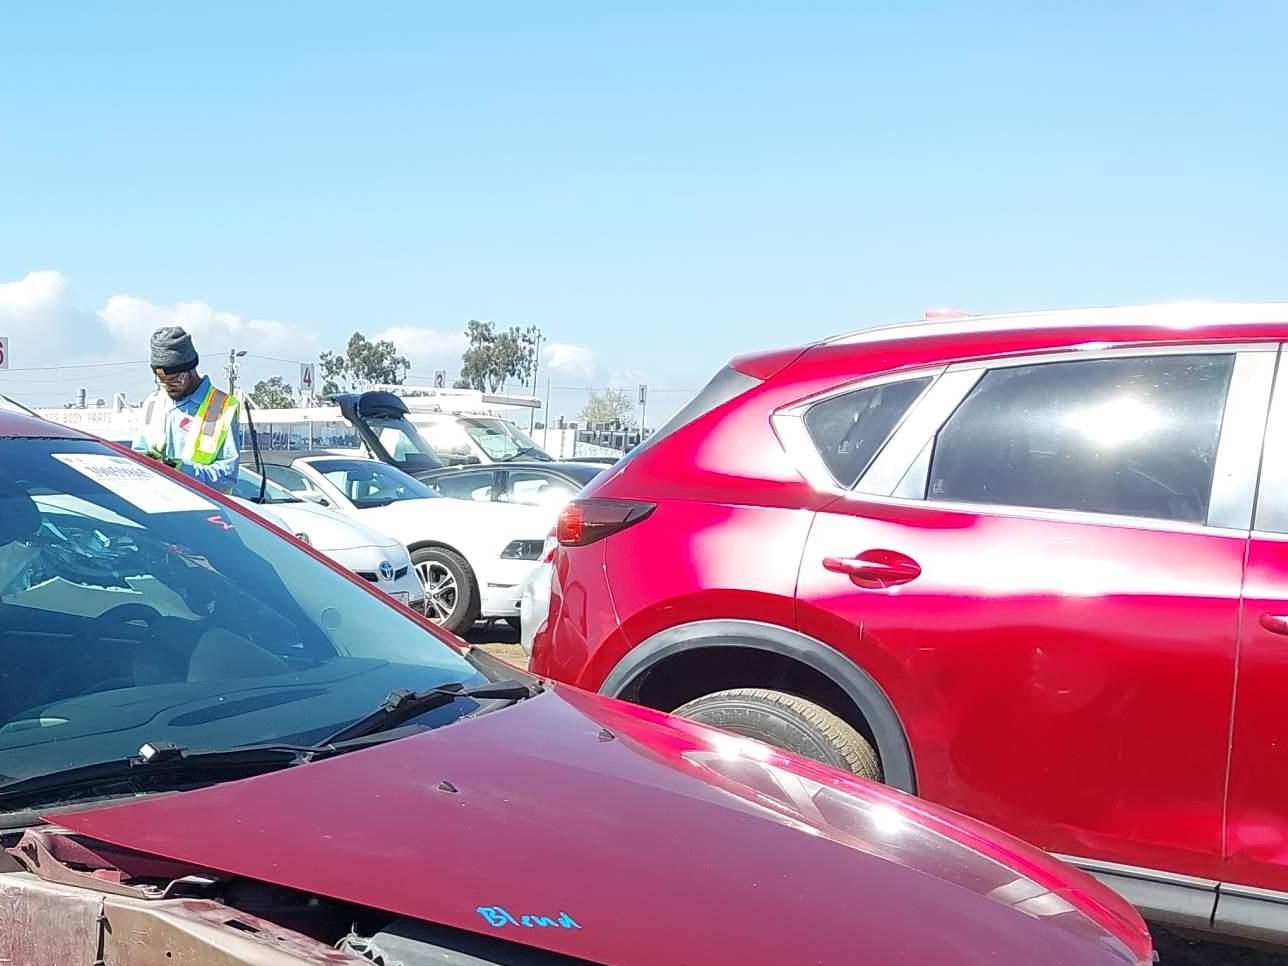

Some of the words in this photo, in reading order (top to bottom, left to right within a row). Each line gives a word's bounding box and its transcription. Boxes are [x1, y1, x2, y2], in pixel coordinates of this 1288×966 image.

[303, 367, 312, 388] 4
[639, 387, 645, 403] 1
[87, 411, 112, 424] PARTS
[476, 905, 582, 929] Blend
